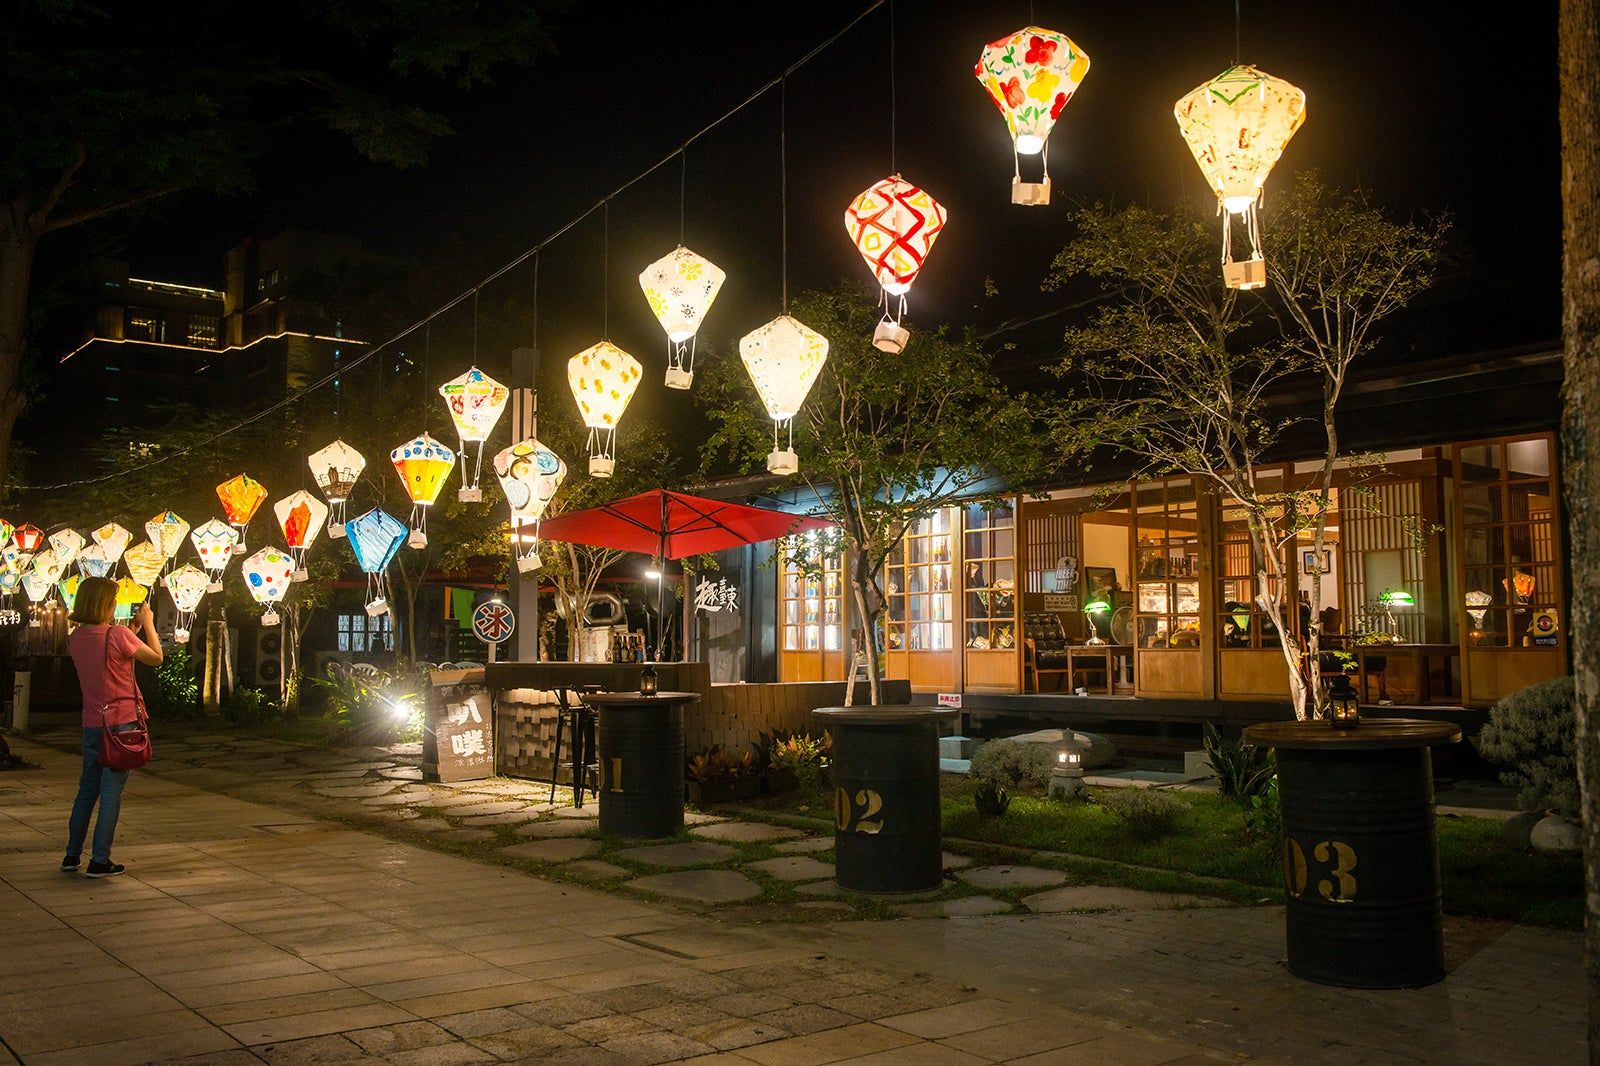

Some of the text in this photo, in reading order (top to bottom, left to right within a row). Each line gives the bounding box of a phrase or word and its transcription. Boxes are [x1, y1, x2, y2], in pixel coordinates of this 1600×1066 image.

[1057, 568, 1075, 579] BEER
[475, 605, 511, 640] 冰
[447, 698, 487, 757] 叭噗
[834, 786, 884, 835] 02
[1284, 837, 1358, 903] 03
